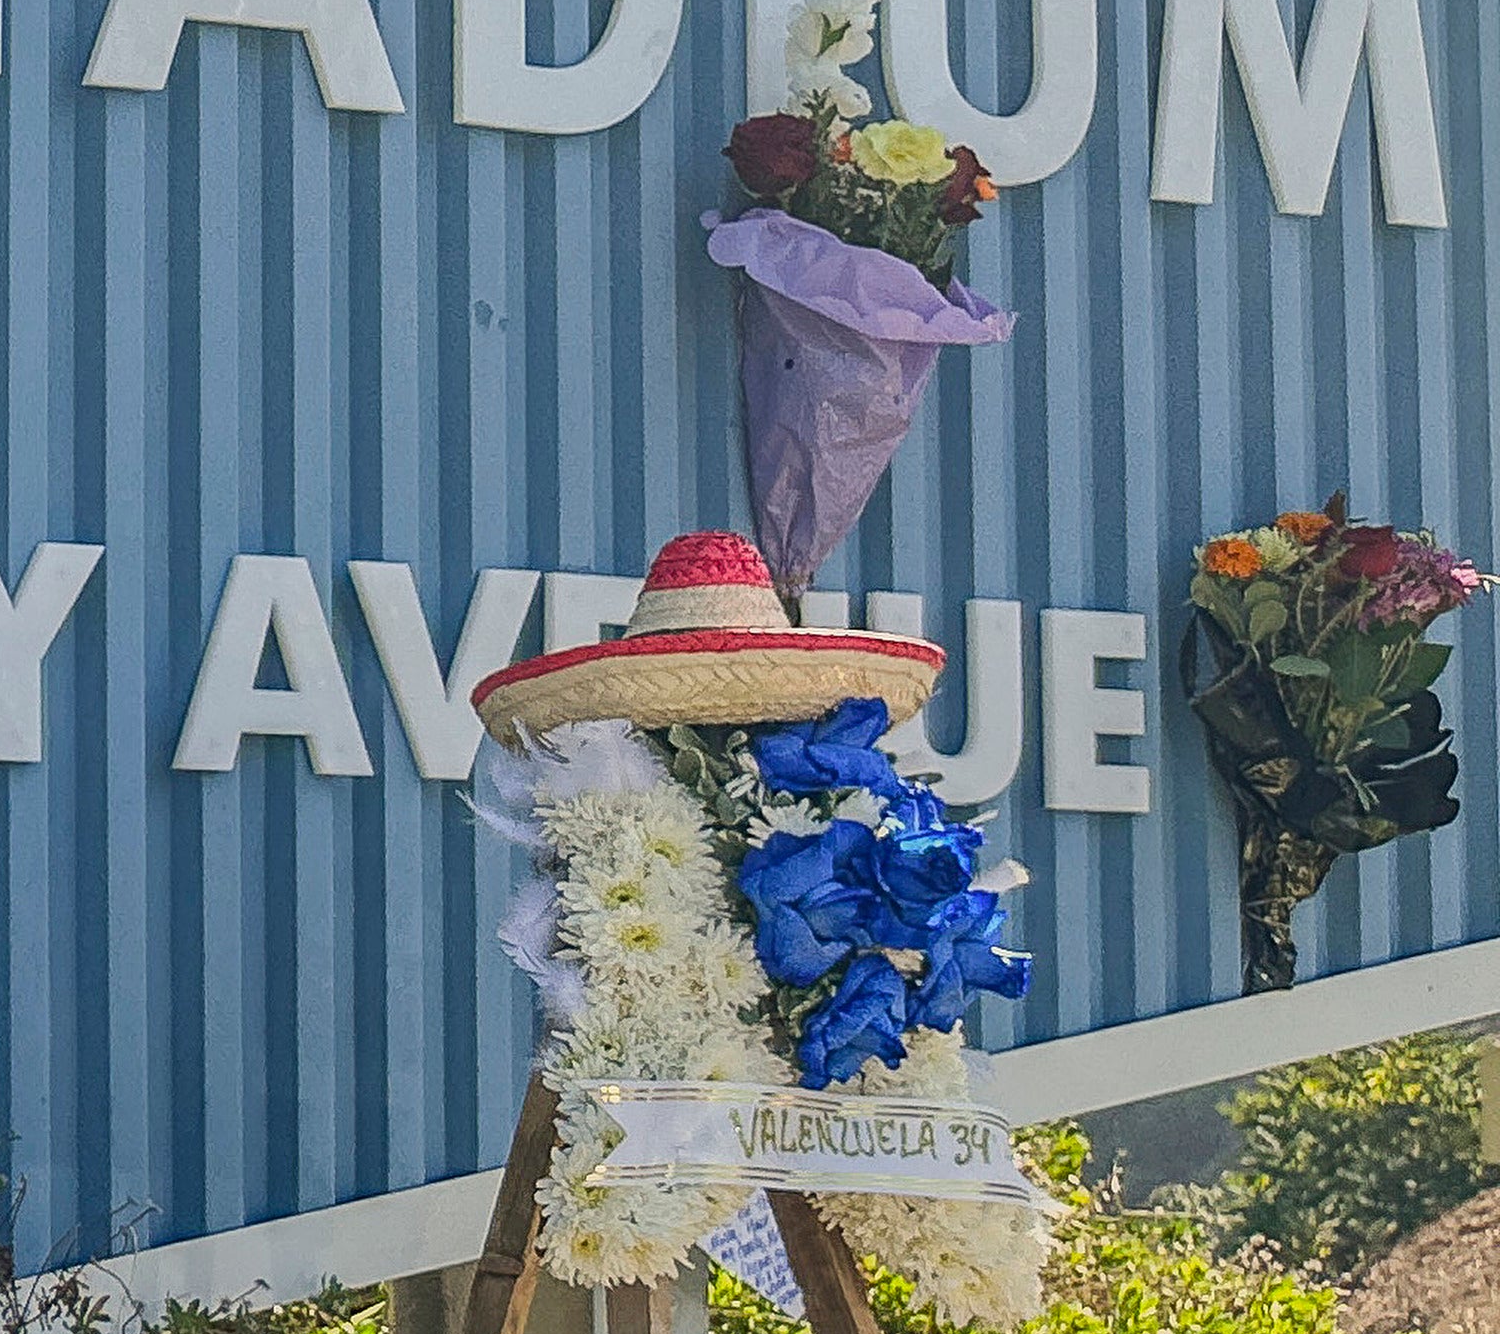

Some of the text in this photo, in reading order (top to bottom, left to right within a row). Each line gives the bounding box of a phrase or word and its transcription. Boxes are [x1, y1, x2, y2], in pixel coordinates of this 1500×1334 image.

[172, 551, 1152, 815] AVUE
[728, 1106, 991, 1166] VALENZUELA 34
